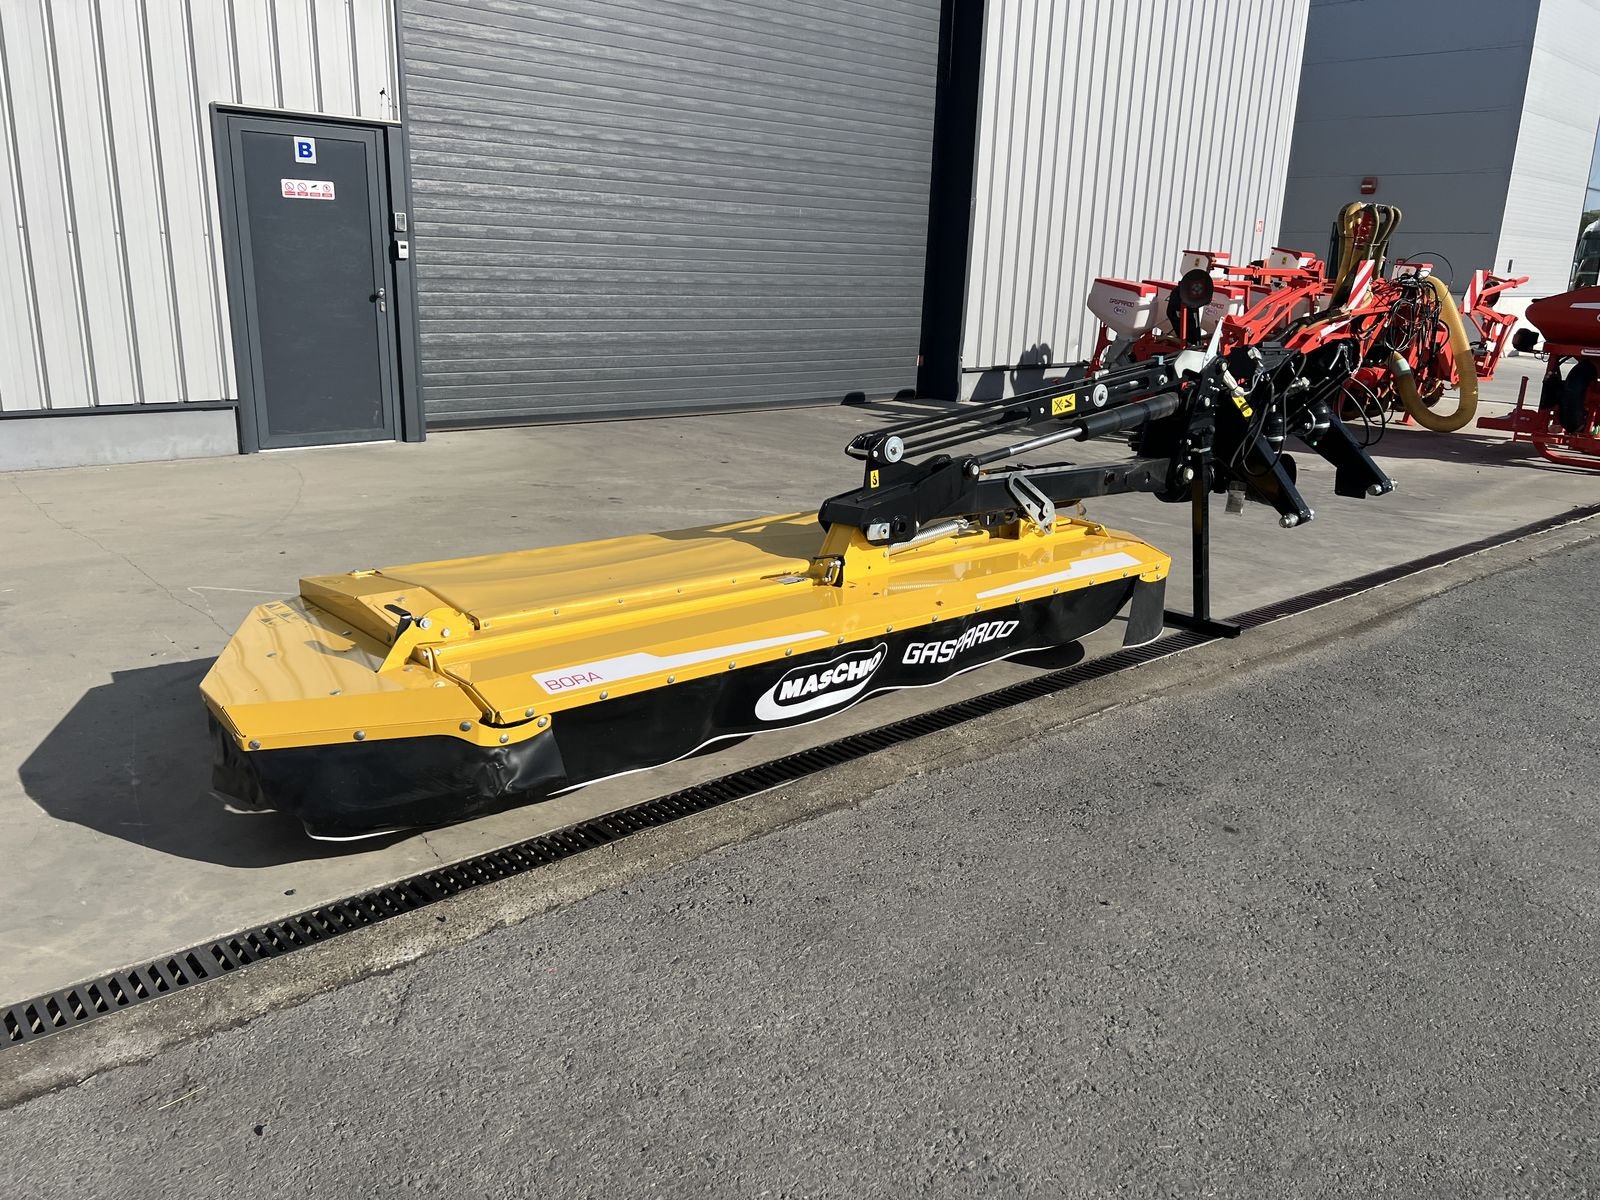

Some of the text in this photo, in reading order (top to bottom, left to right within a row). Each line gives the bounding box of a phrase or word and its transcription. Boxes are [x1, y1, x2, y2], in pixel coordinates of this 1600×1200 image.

[298, 142, 313, 158] B
[1109, 297, 1135, 308] GASPARDO
[778, 620, 1019, 701] MASCHIO GASPARDO
[544, 671, 604, 691] BORA
